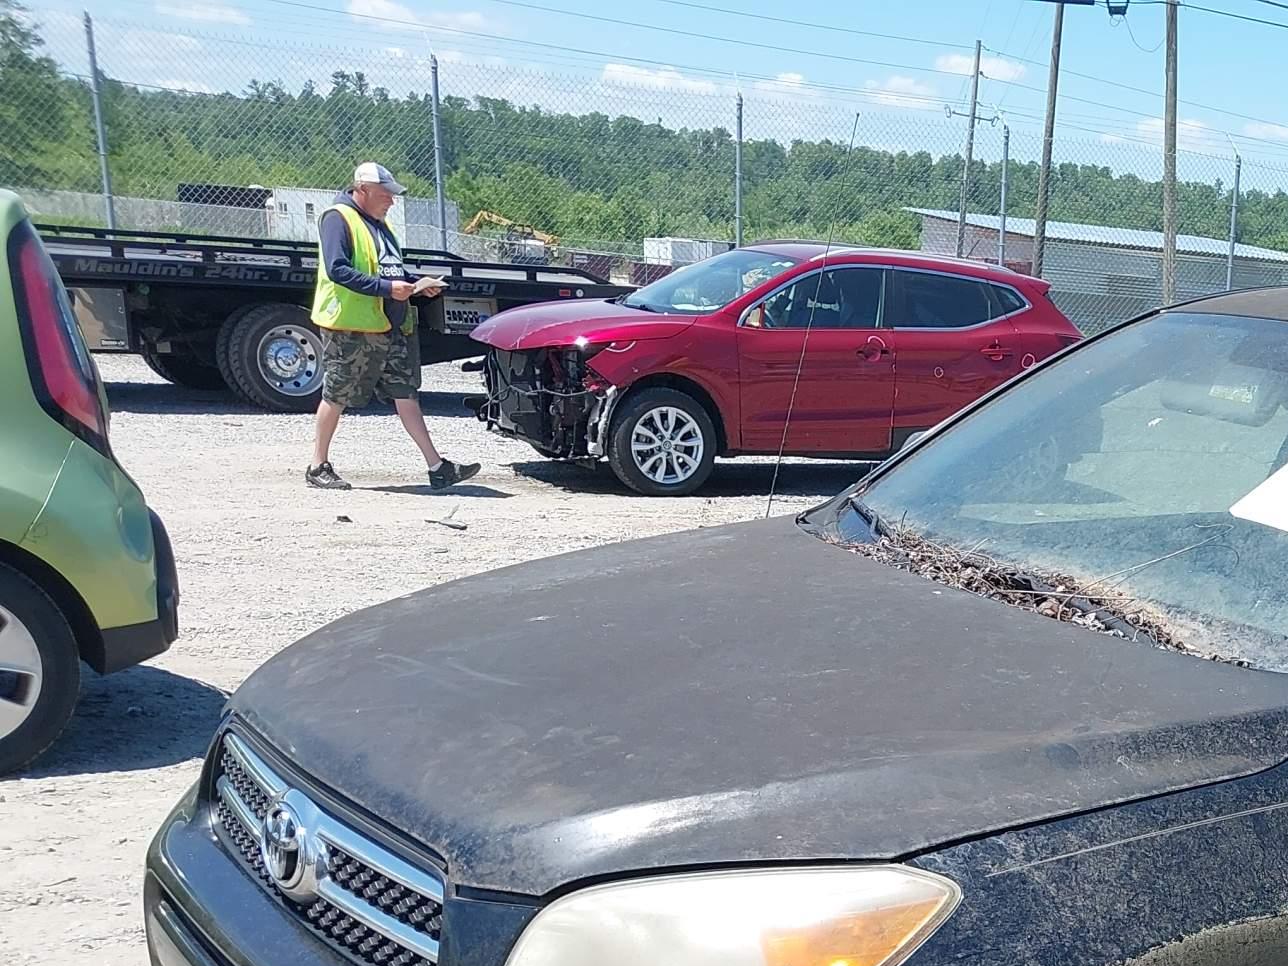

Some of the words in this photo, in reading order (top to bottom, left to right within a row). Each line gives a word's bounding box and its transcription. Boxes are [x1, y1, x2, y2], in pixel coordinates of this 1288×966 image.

[74, 258, 194, 278] Mauldin's
[204, 264, 269, 281] 24hr.
[449, 281, 496, 296] very
